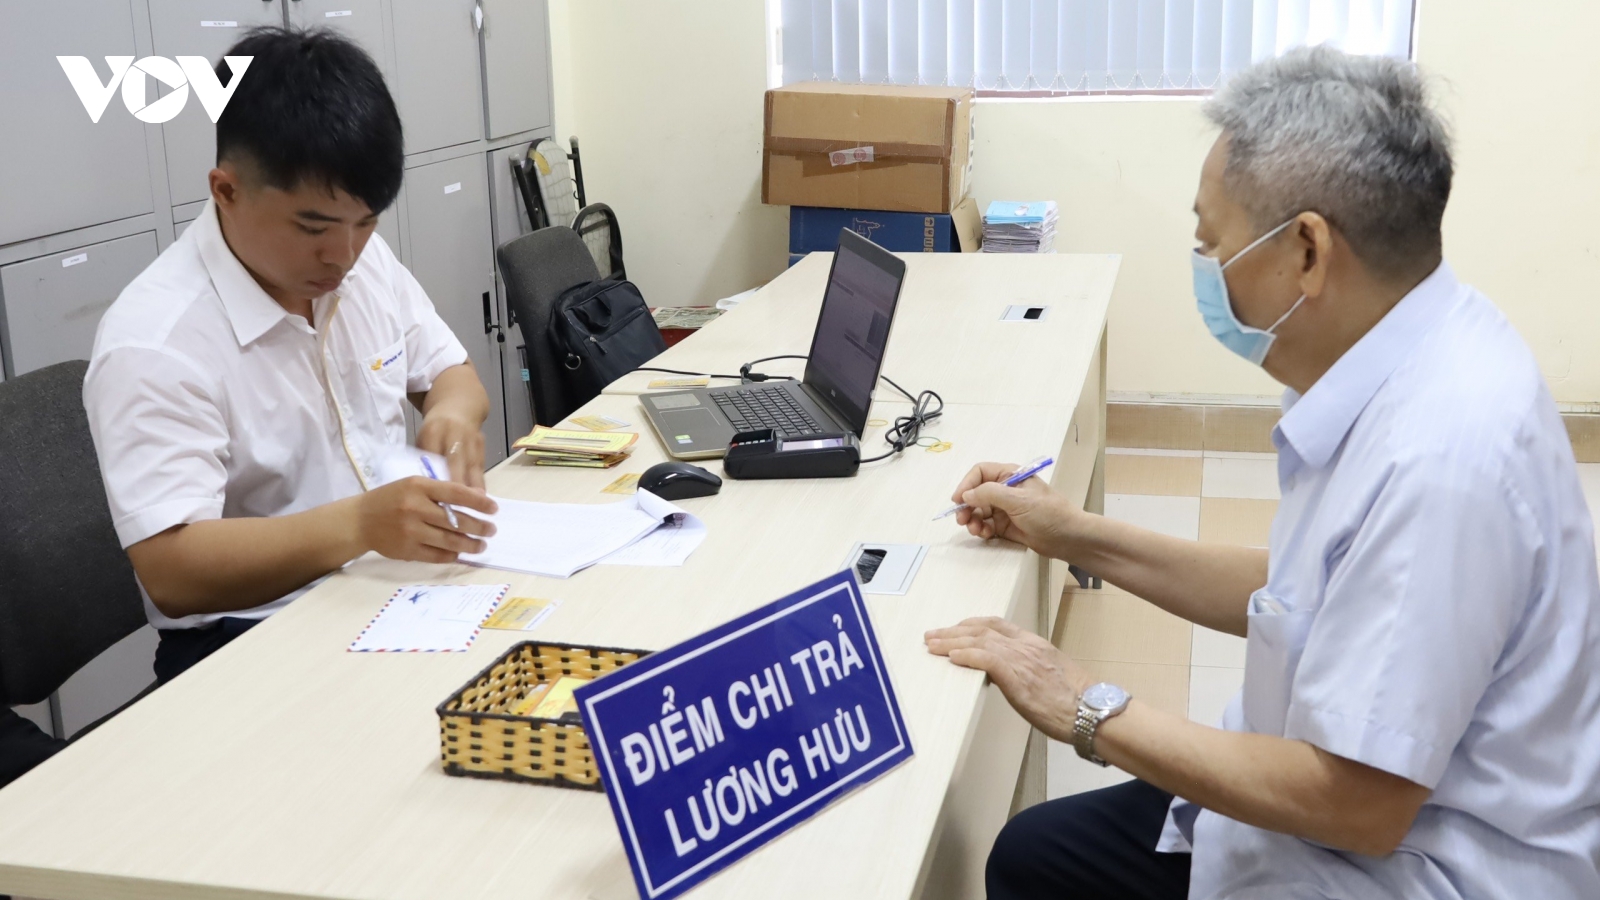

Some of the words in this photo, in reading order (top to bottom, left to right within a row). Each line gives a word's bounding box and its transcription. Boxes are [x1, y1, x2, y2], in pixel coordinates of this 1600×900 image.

[620, 685, 725, 786] ĐIỂM
[728, 662, 793, 729] CHI
[790, 613, 864, 695] TRẢ
[664, 748, 798, 857] LƯƠNG
[799, 704, 871, 779] HƯU
